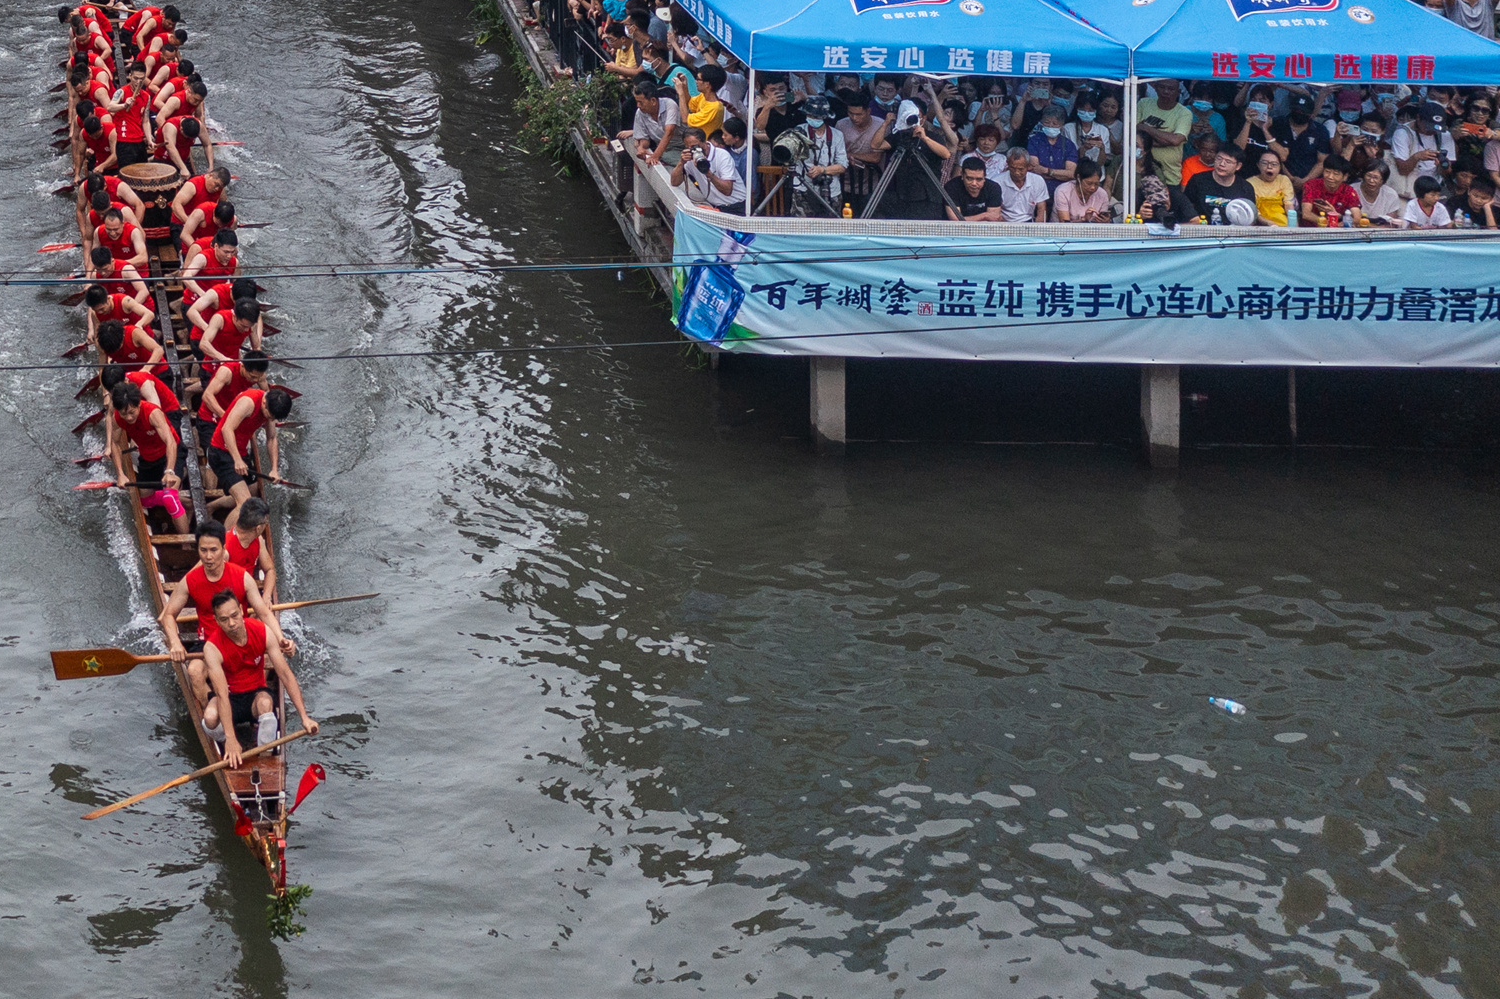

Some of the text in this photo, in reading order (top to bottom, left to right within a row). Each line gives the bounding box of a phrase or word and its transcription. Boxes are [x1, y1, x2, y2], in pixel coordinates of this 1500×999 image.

[882, 10, 940, 20] 包装饮用水
[1266, 17, 1330, 27] 包装饮用水
[822, 45, 1052, 75] 选安心 选健康
[1211, 52, 1436, 80] 选安心 选健康
[936, 278, 1025, 318] 蓝纯
